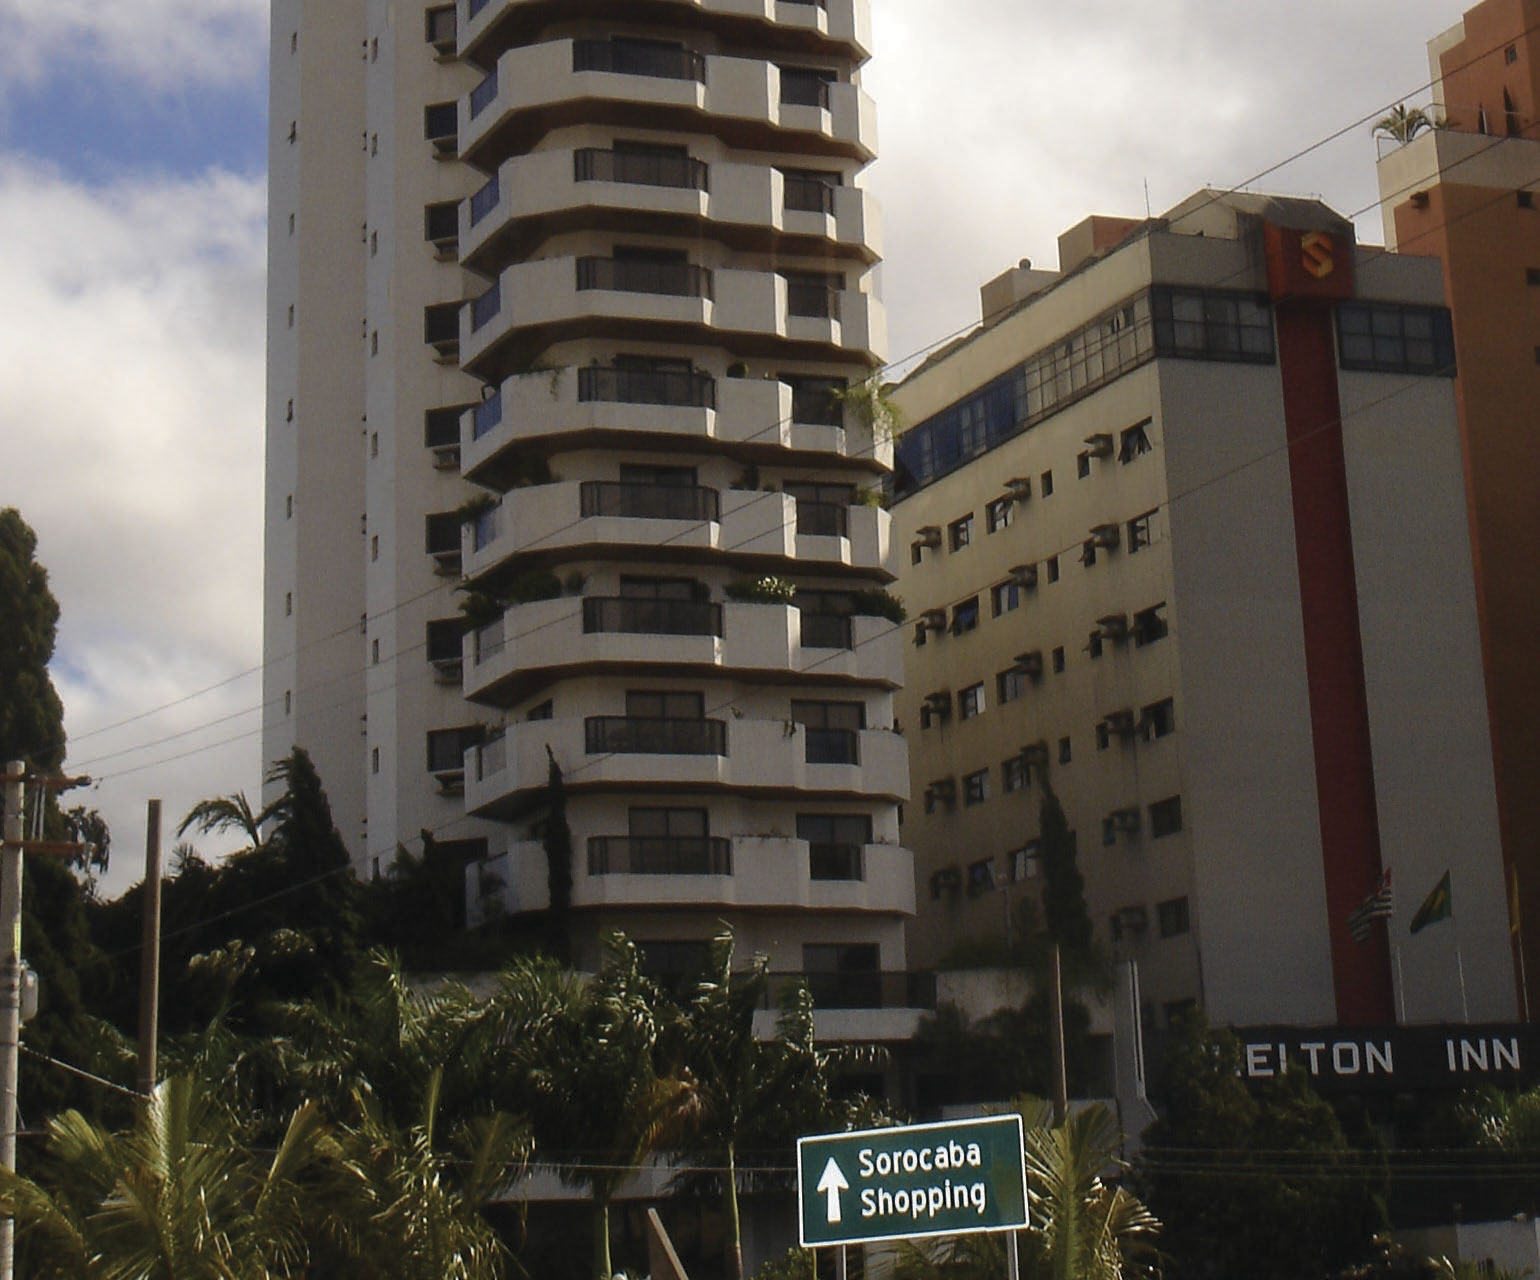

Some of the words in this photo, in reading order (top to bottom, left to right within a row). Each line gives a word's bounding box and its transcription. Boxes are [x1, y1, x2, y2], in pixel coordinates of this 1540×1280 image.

[1446, 1037, 1520, 1072] INN
[858, 1139, 981, 1177] Sorocaba
[861, 1179, 986, 1219] Shopping
